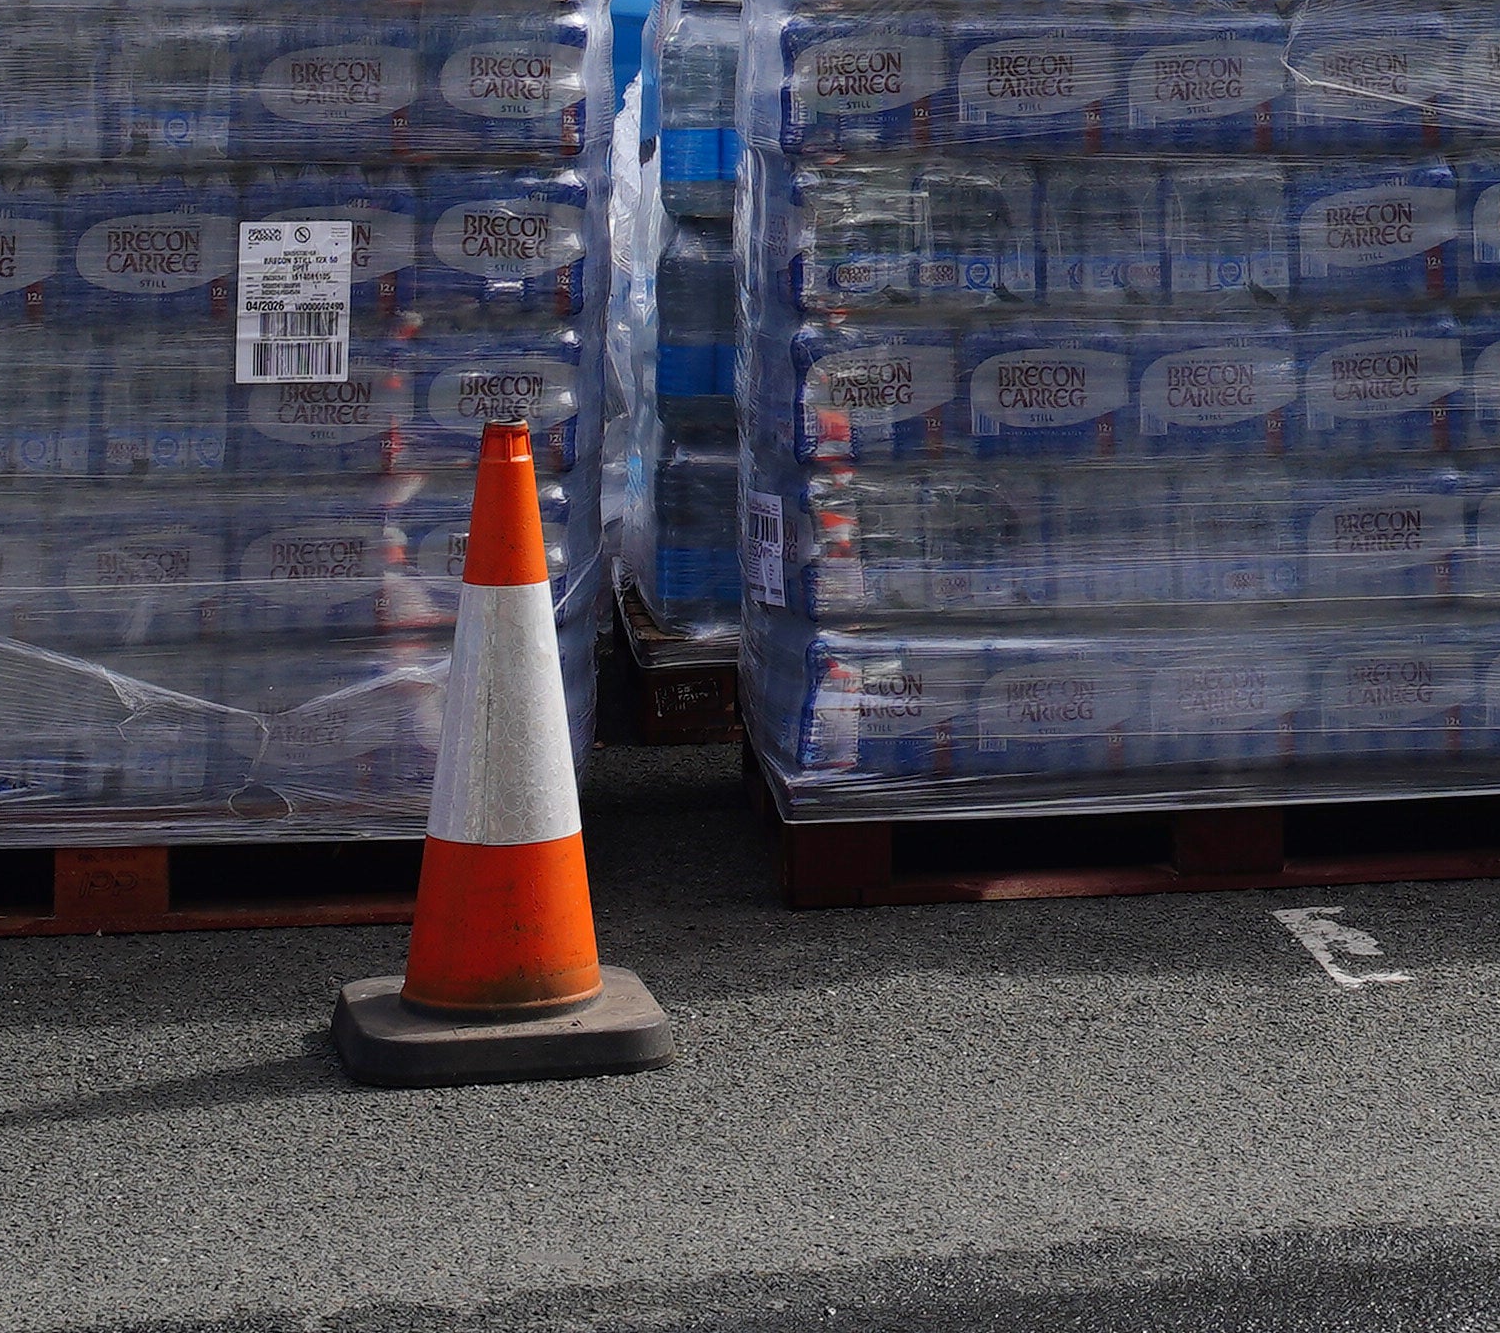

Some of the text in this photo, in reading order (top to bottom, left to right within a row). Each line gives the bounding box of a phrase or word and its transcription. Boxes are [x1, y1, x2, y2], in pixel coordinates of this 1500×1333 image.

[291, 62, 381, 83] BRECON
[816, 53, 900, 75] BRECON
[987, 56, 1074, 76] BRECON
[1155, 58, 1242, 79] BRECON
[817, 75, 900, 95] CARREG
[987, 77, 1075, 97] CARREG
[1154, 79, 1244, 100] CARREG
[501, 105, 529, 113] STILL
[462, 214, 549, 236] BRECON
[1325, 204, 1412, 225] BRECON
[107, 232, 200, 253] BRECON
[1326, 226, 1413, 249] CARREG
[106, 253, 200, 274] CARREG
[246, 301, 285, 311] 04/2026
[1332, 354, 1419, 376] BRECON
[460, 375, 543, 397] BRECON
[999, 366, 1086, 387] BRECON
[1167, 365, 1254, 387] BRECON
[830, 385, 914, 408] CARREG
[999, 388, 1087, 408] CARREG
[1167, 387, 1255, 408] CARREG
[278, 404, 370, 424] CARREG
[1335, 510, 1421, 533] BRECON
